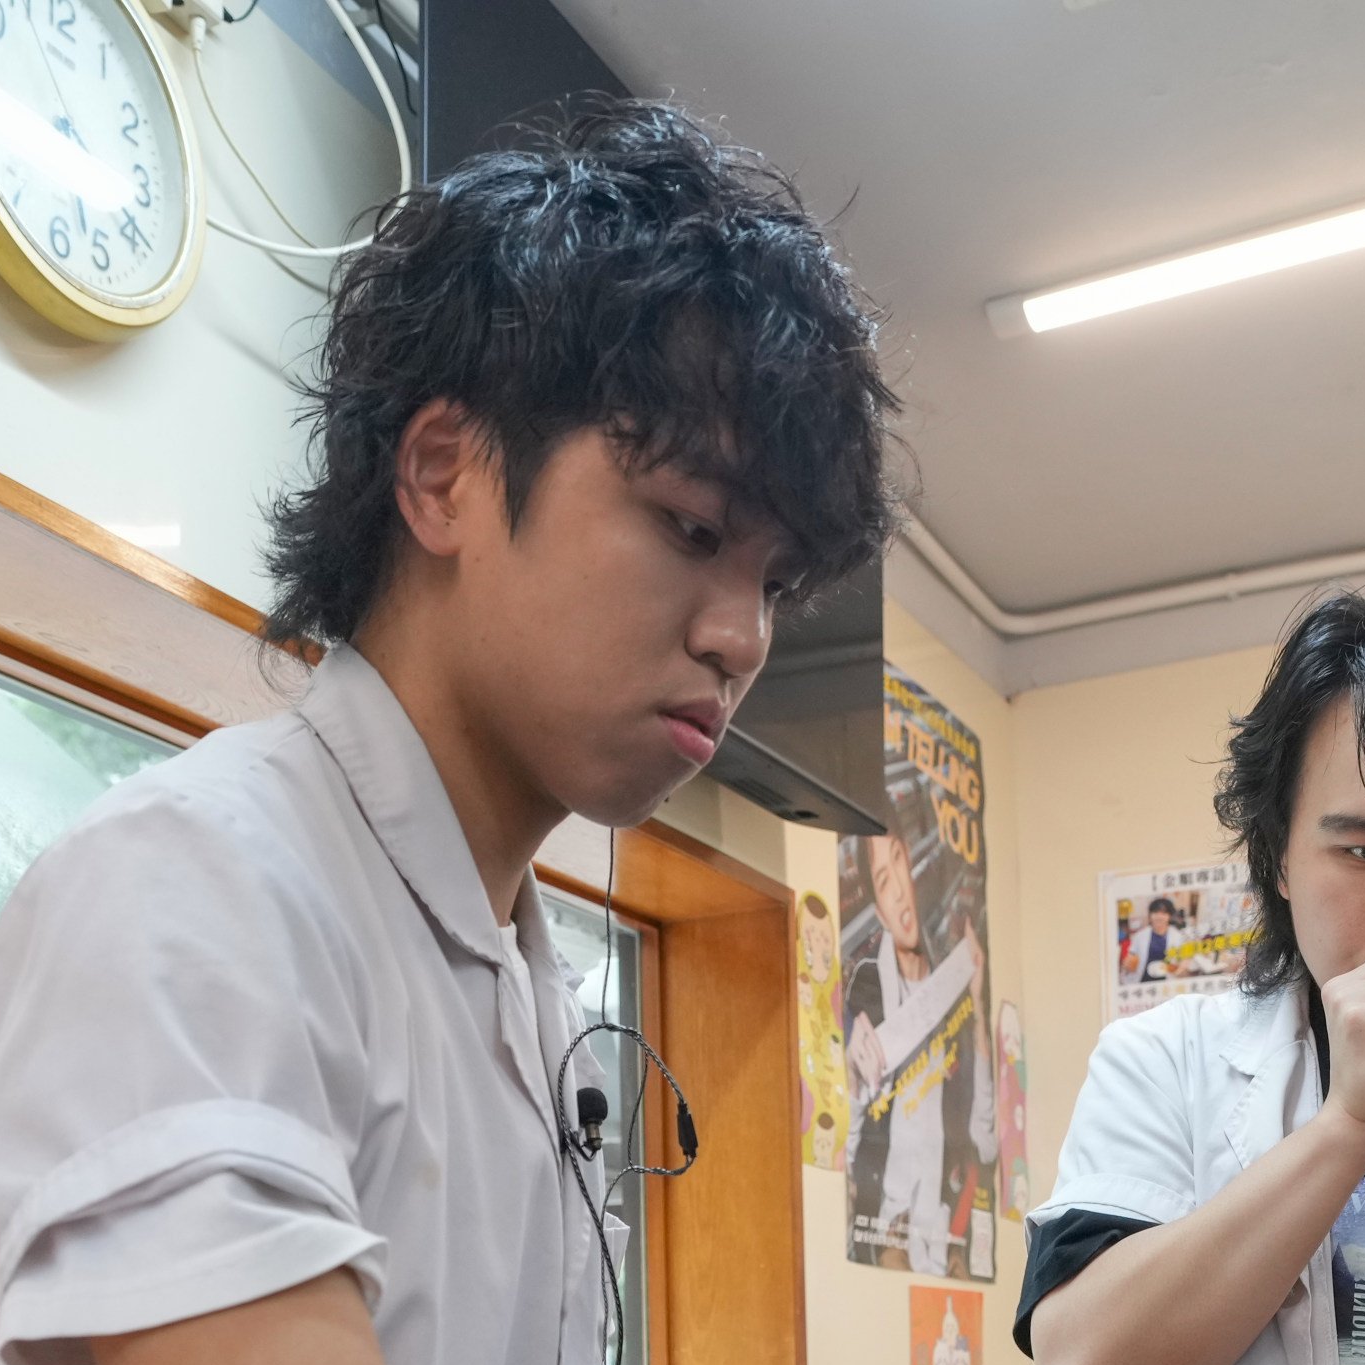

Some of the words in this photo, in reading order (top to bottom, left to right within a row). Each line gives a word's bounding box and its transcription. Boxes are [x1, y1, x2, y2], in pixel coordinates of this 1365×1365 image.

[49, 0, 76, 43] 12
[122, 102, 139, 146] 2
[134, 163, 151, 207] 3
[49, 216, 70, 258] 6
[92, 228, 110, 270] 5
[930, 783, 980, 865] YOU
